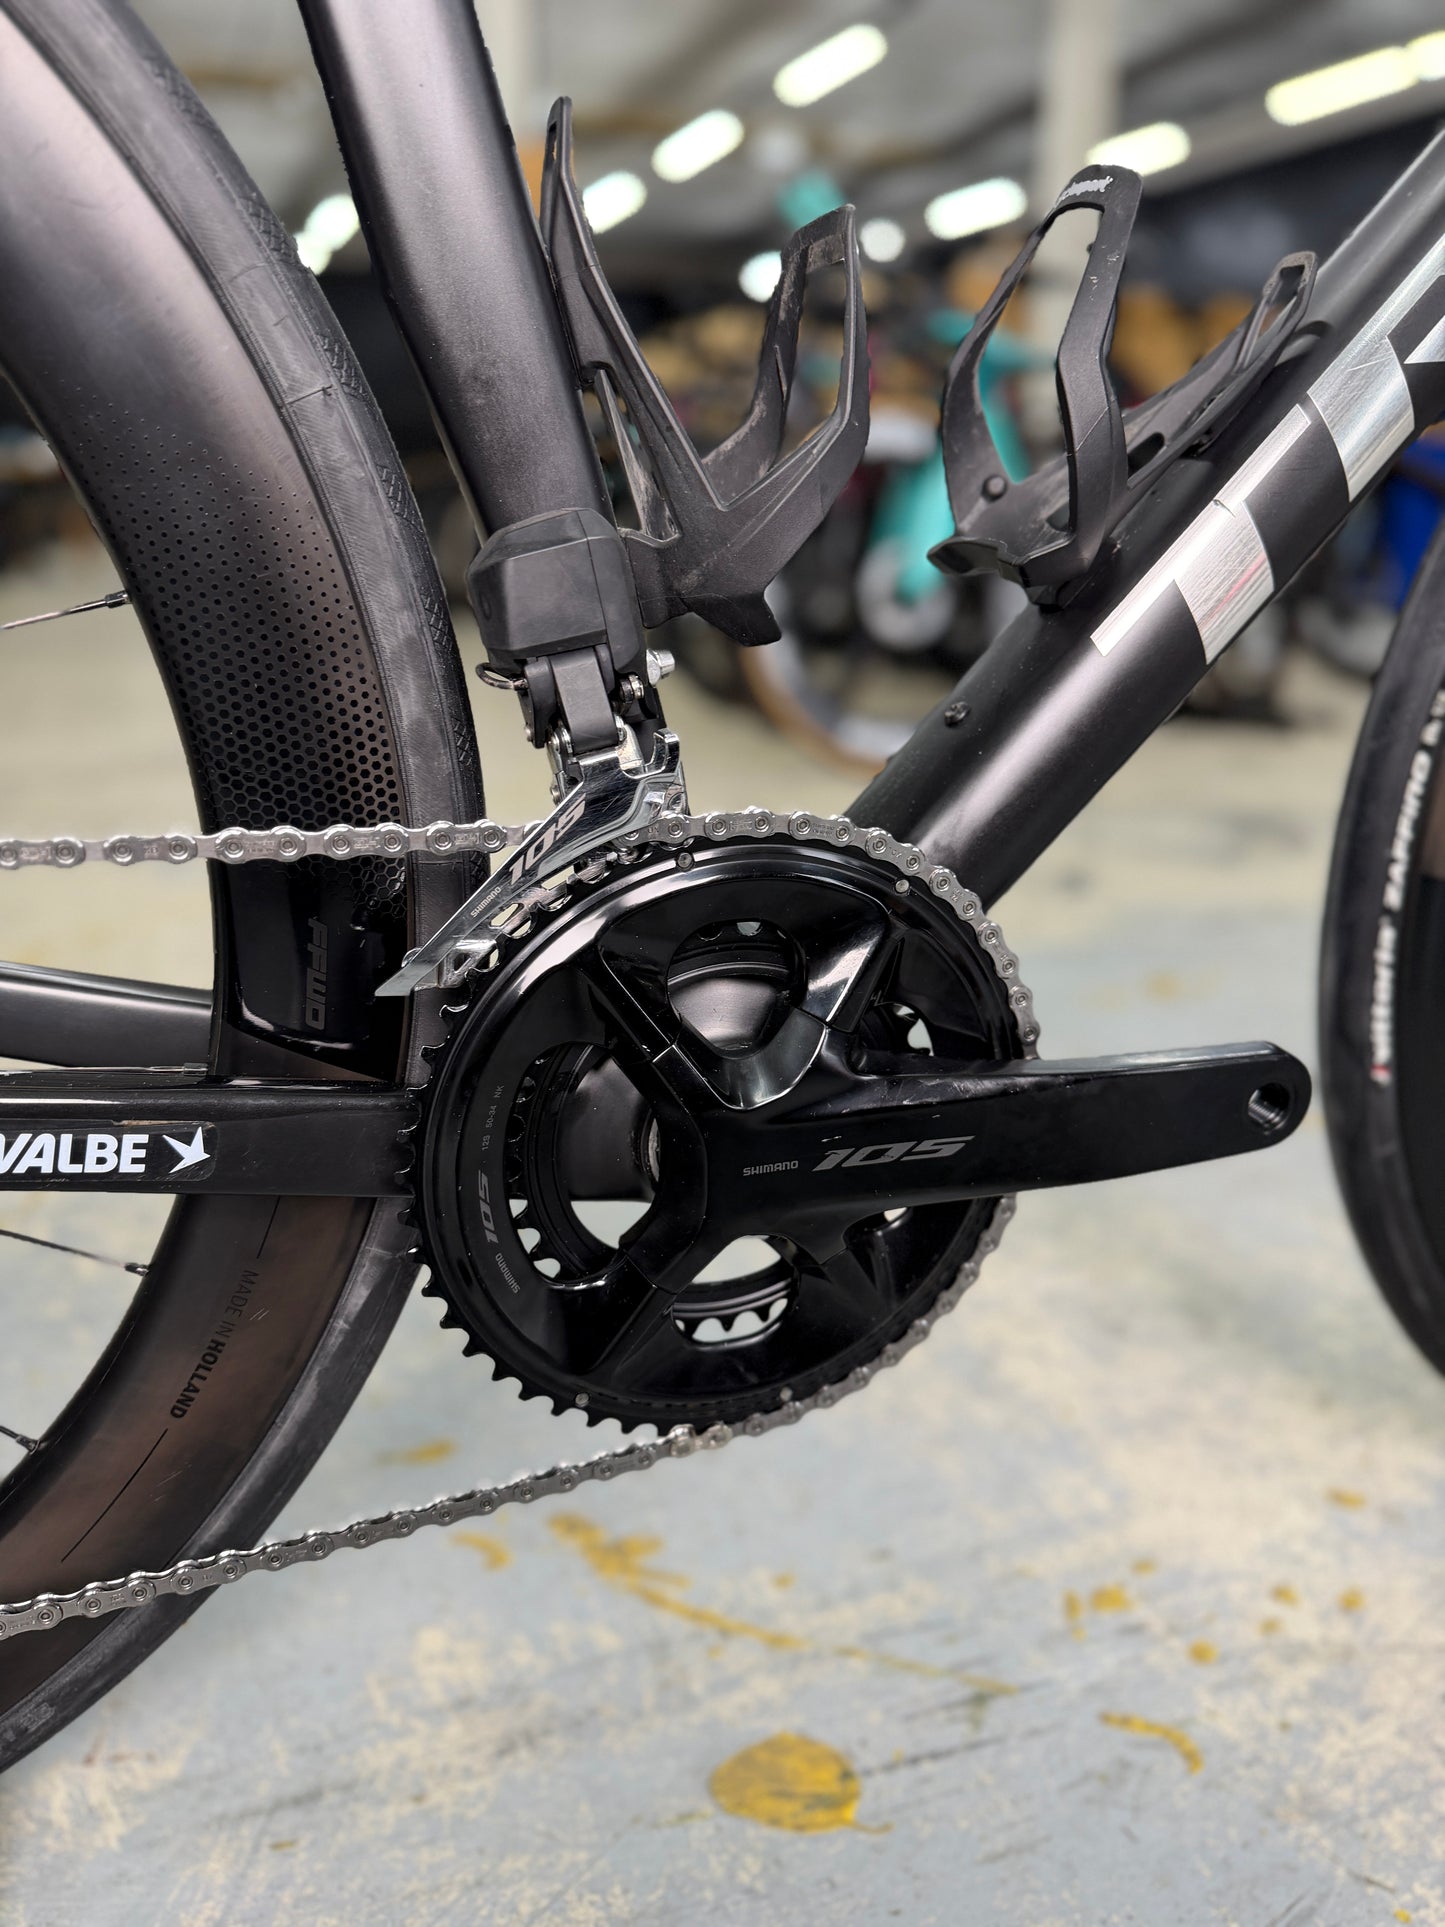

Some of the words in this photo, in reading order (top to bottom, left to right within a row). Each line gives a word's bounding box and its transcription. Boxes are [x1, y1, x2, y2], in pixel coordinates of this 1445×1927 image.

[470, 886, 502, 918] SHIMANO
[508, 792, 586, 886] 105
[493, 1085, 505, 1098] NK
[485, 1105, 497, 1128] 50-34
[743, 1160, 799, 1176] SHIMANO
[812, 1135, 976, 1171] 105
[478, 1169, 499, 1244] 105
[225, 1269, 260, 1318] MADE
[495, 1252, 521, 1294] SHIMANO
[215, 1320, 237, 1338] IN
[170, 1338, 227, 1419] HOLLAND
